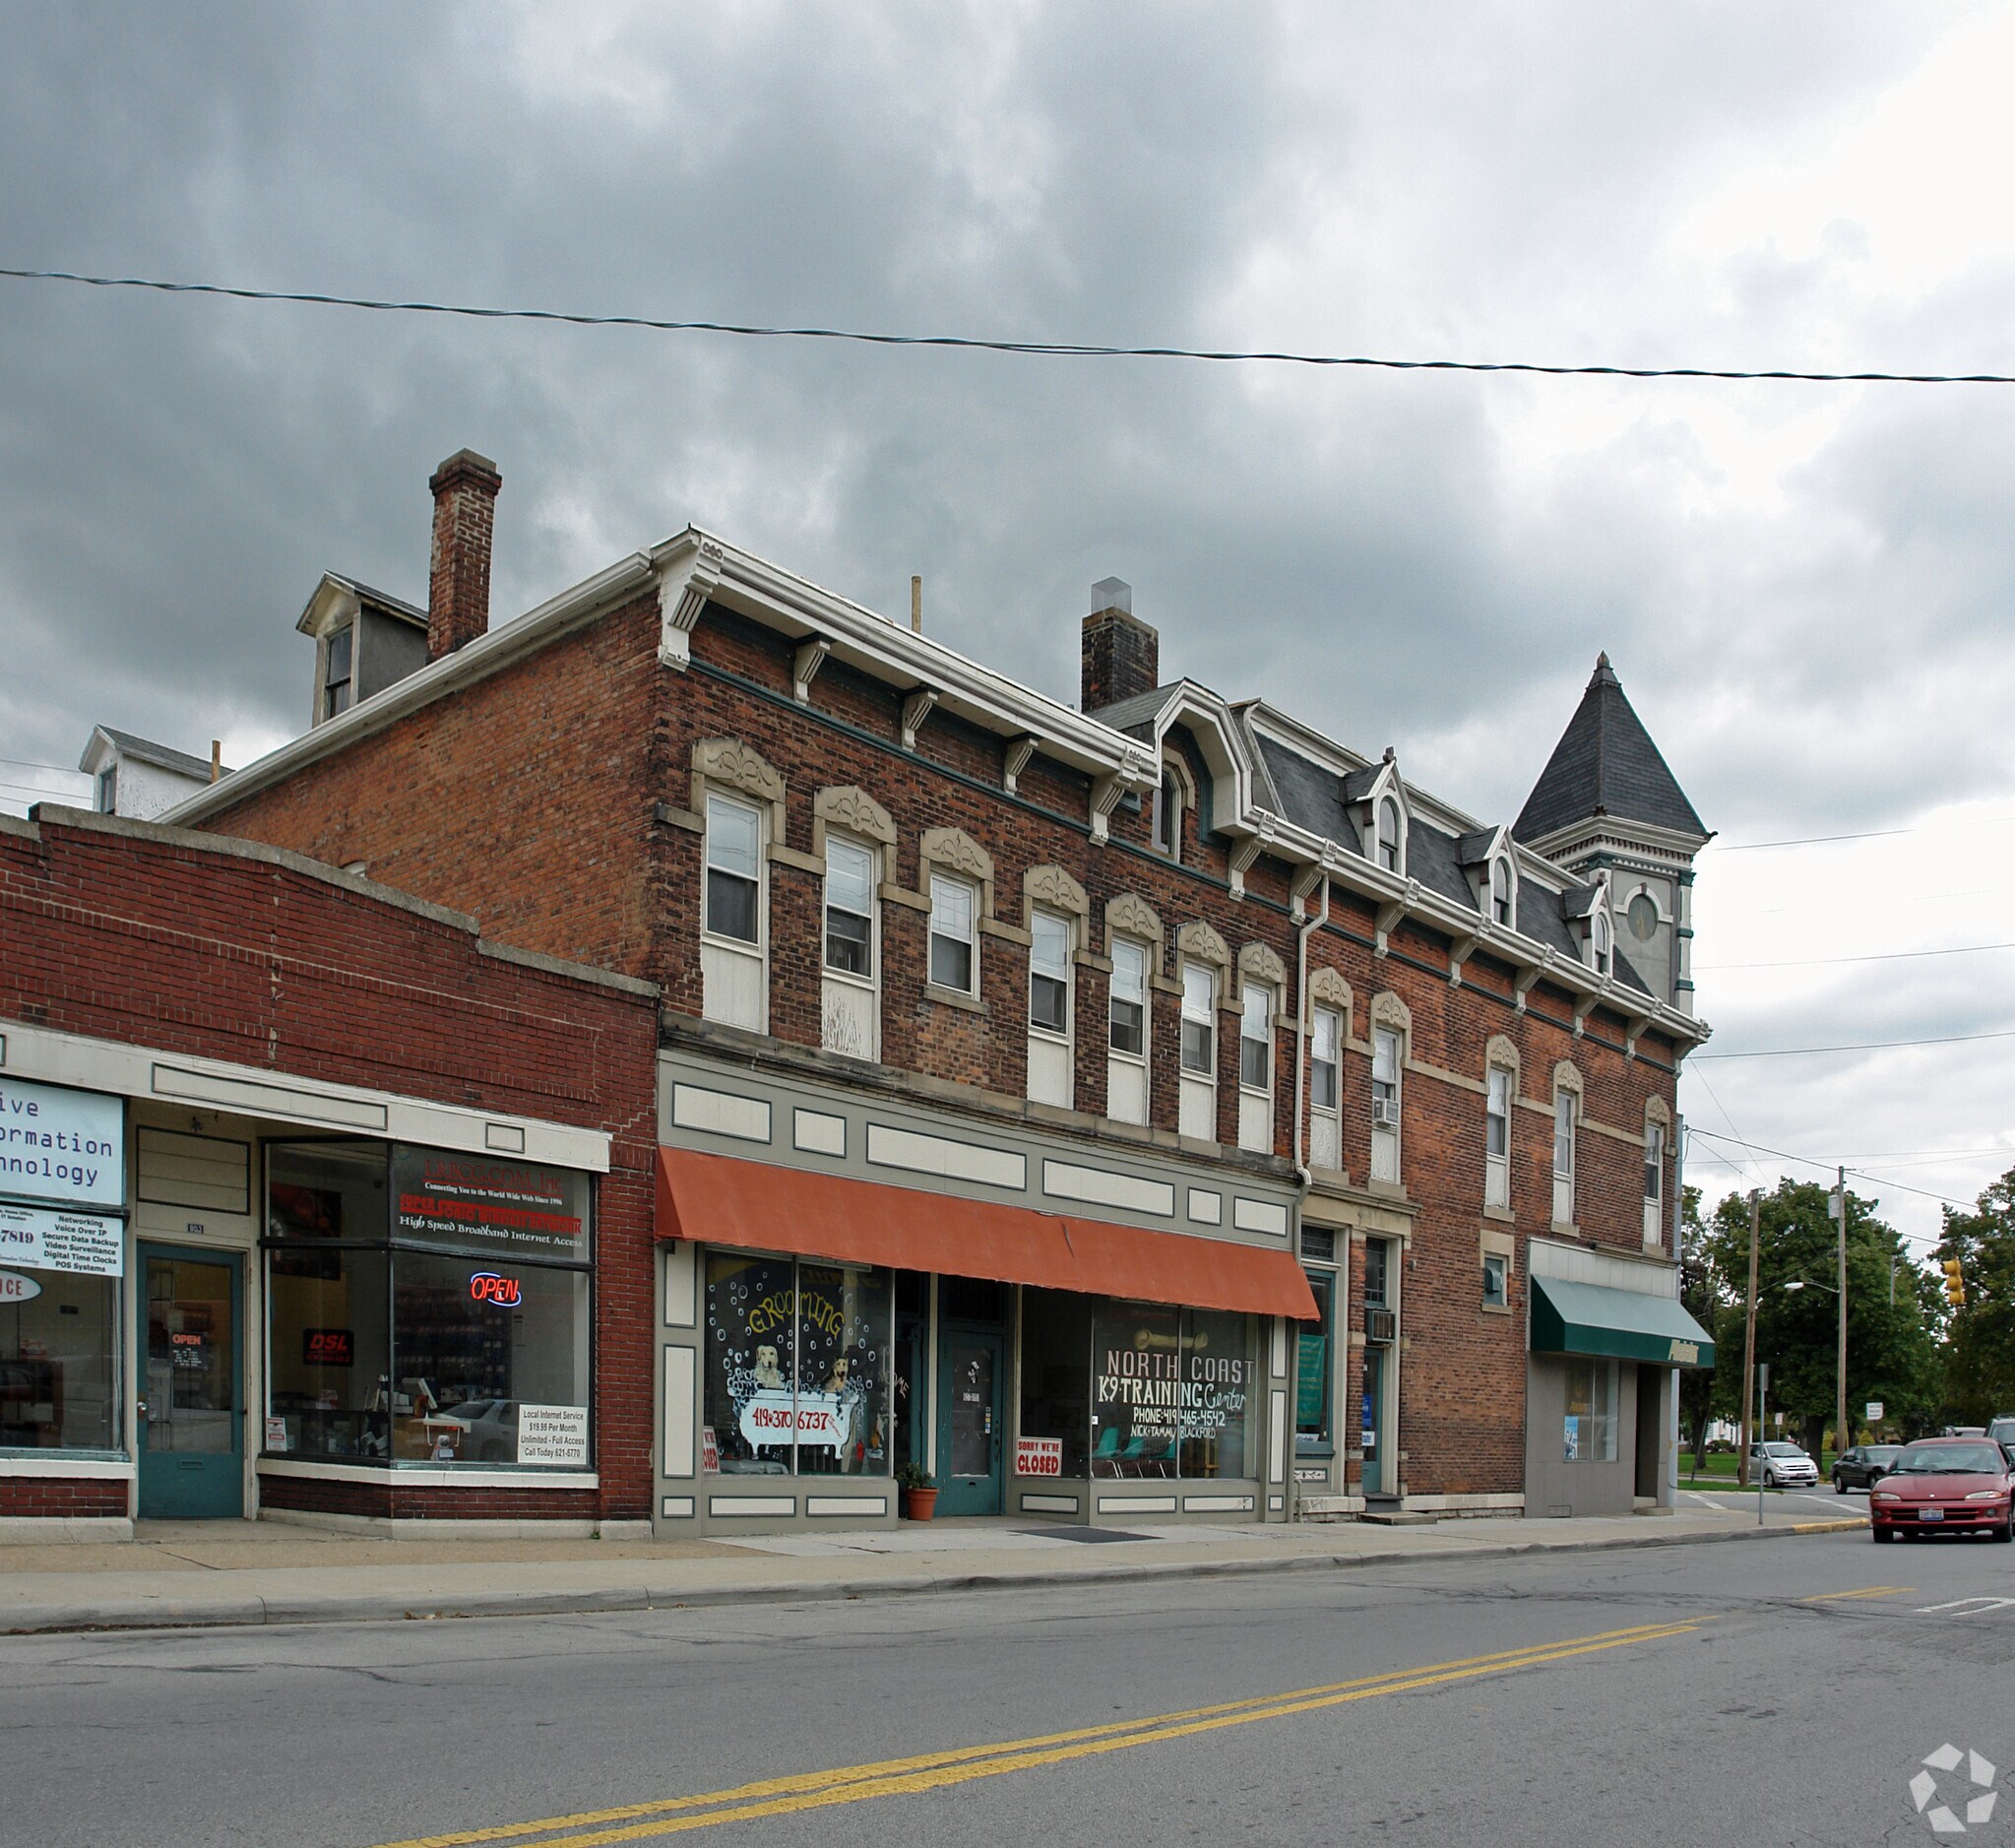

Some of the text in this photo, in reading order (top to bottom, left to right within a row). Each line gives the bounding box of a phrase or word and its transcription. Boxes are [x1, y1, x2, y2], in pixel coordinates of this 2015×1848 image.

[424, 1182, 458, 1195] Connecting
[470, 1186, 476, 1195] to
[477, 1187, 487, 1196] the
[487, 1189, 506, 1199] World
[522, 1193, 534, 1202] Web
[535, 1195, 549, 1204] Since
[59, 1215, 103, 1228] Networking
[54, 1224, 76, 1233] Voice
[78, 1227, 95, 1236] Over
[400, 1215, 583, 1248] High Speed Broadband Internet Access
[42, 1232, 69, 1242] Secure
[92, 1238, 119, 1247] Backup
[69, 1243, 116, 1255] Surveillance
[43, 1250, 69, 1259] Digital
[93, 1255, 117, 1265] Clocks
[55, 1260, 106, 1272] POS Systems
[472, 1277, 519, 1302] OPEN
[172, 1334, 201, 1345] OPEN
[309, 1333, 347, 1352] DSL
[1107, 1350, 1255, 1385] NORTH COAST
[1205, 1383, 1246, 1411] Center
[524, 1410, 584, 1420] Local Internet Service
[797, 1411, 830, 1431] 6737
[1180, 1410, 1227, 1427] 465-4542
[530, 1423, 578, 1433] $19.95 Per Month
[521, 1434, 547, 1443] Unlimited
[552, 1435, 563, 1444] Full
[564, 1436, 585, 1445] Access
[1018, 1441, 1060, 1452] SORRY WE'RE
[525, 1447, 535, 1456] Call
[536, 1447, 554, 1459] Today
[1018, 1454, 1059, 1474] CLOSED
